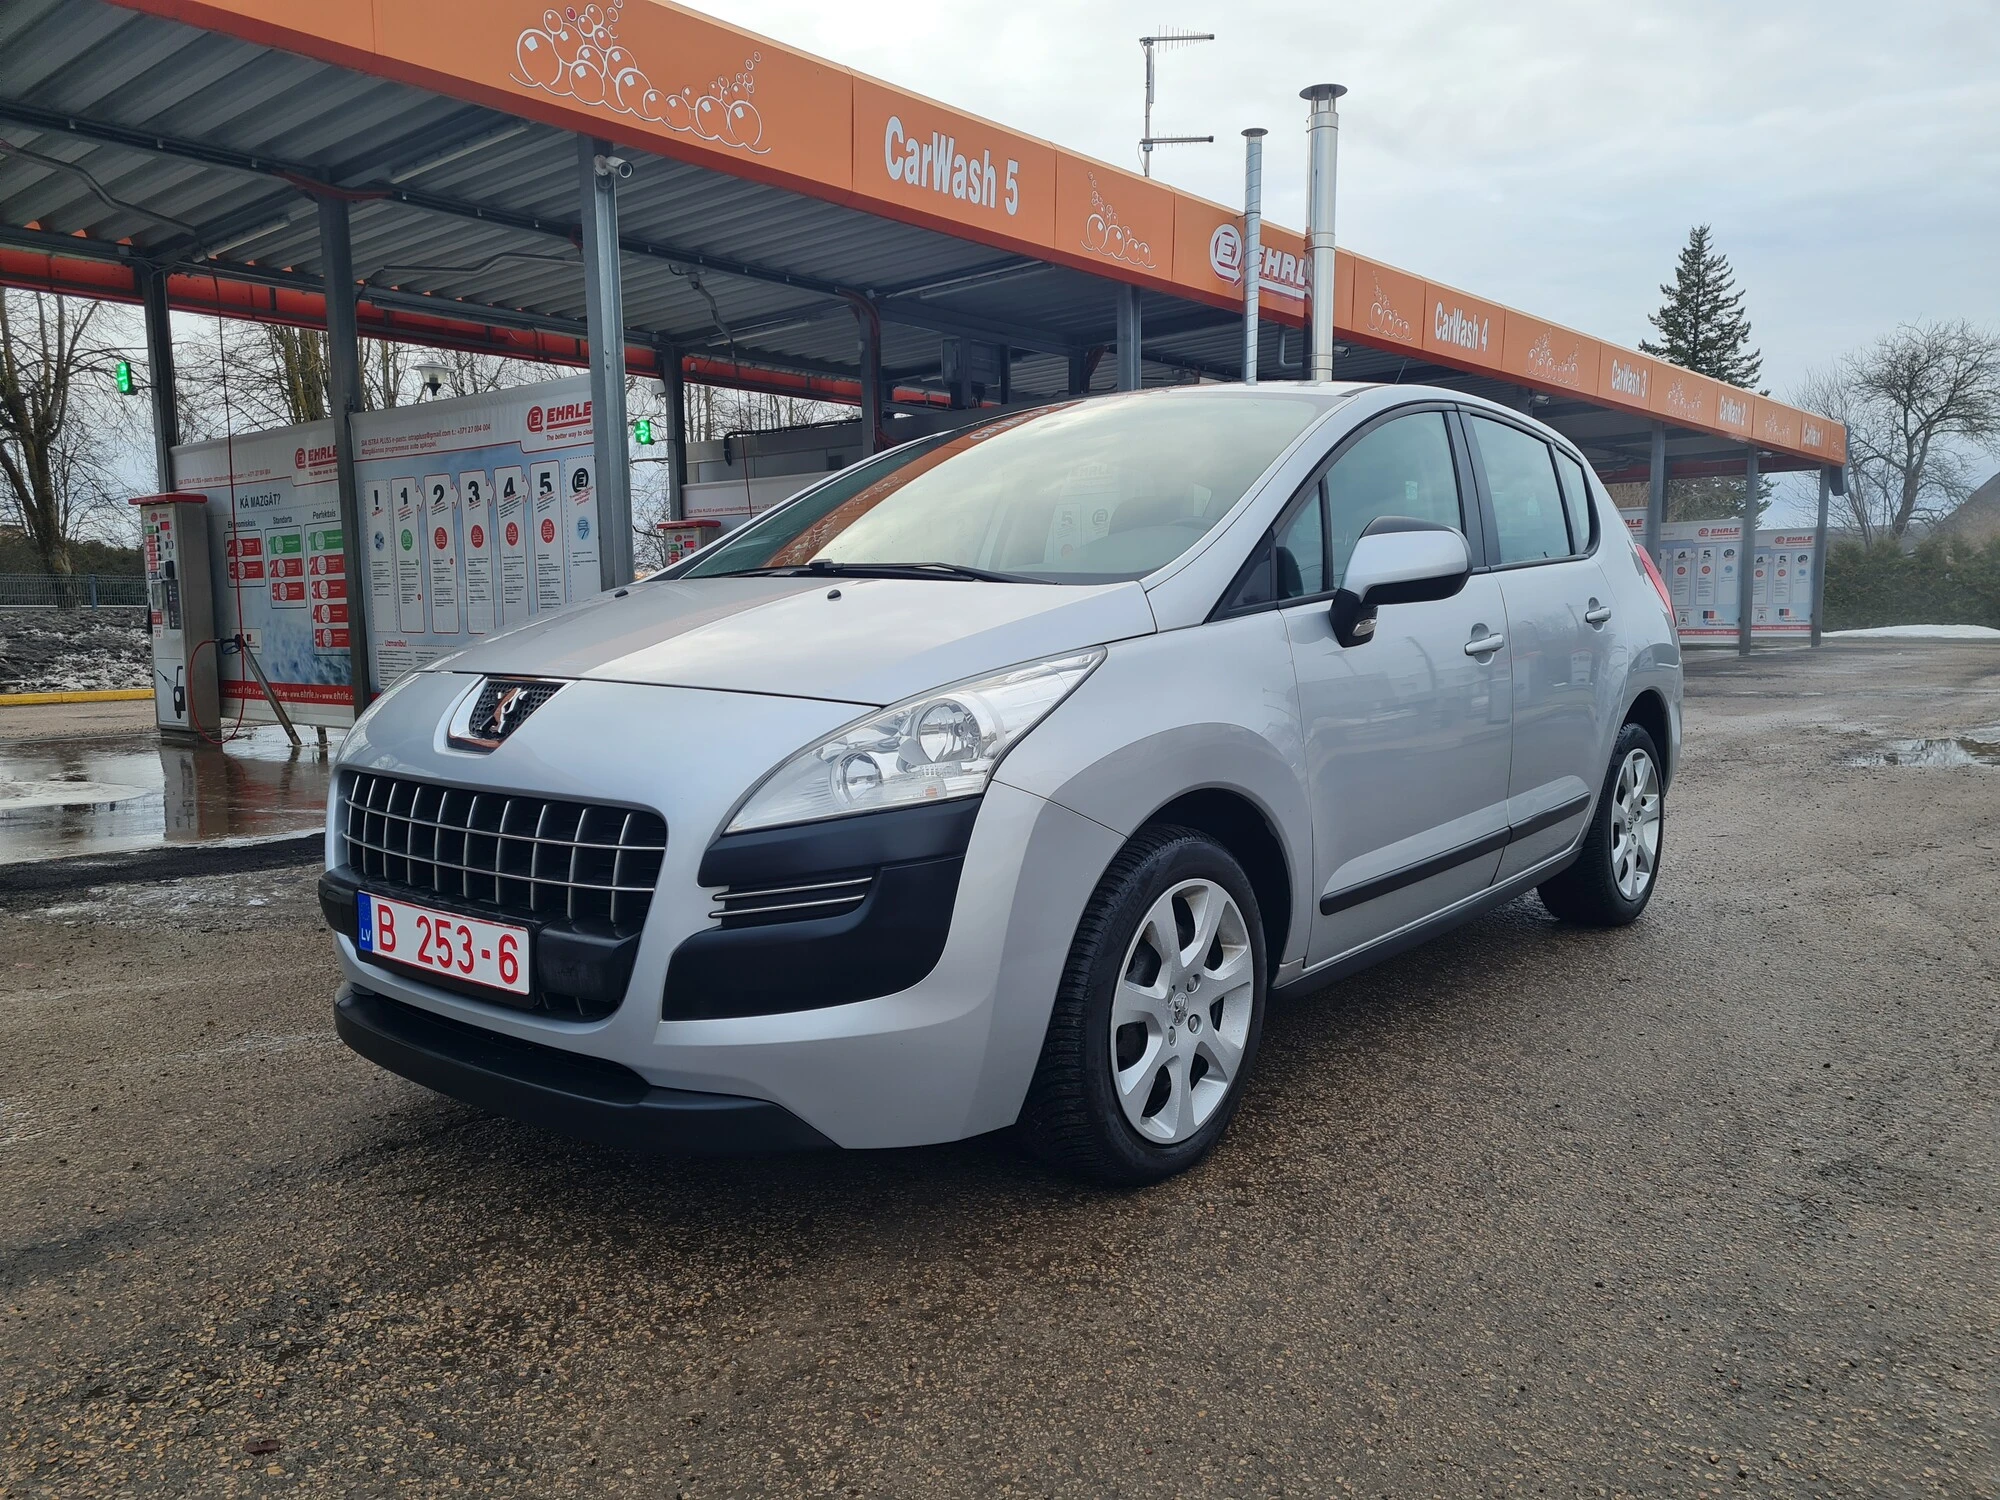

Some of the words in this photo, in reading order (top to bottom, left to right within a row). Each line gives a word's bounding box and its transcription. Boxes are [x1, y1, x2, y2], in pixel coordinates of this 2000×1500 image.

[884, 115, 996, 209] CarWash
[1004, 158, 1019, 216] 5
[1435, 301, 1479, 350] CarWash
[1481, 318, 1489, 352] 4
[1611, 358, 1640, 395] CarWash
[1641, 369, 1648, 398] 3
[547, 401, 592, 422] EHRLE
[308, 445, 337, 462] EHRLE
[433, 484, 444, 505] 2
[468, 480, 480, 504] 3
[504, 477, 515, 498] 4
[540, 472, 552, 496] 5
[240, 496, 248, 509] KĀ
[250, 492, 281, 508] MAZGĀT?
[400, 487, 408, 505] 1
[228, 519, 256, 528] Eknomiskais
[1710, 527, 1740, 535] EHRLE
[361, 927, 371, 942] LV
[377, 903, 397, 952] B
[416, 915, 519, 985] 253-6
